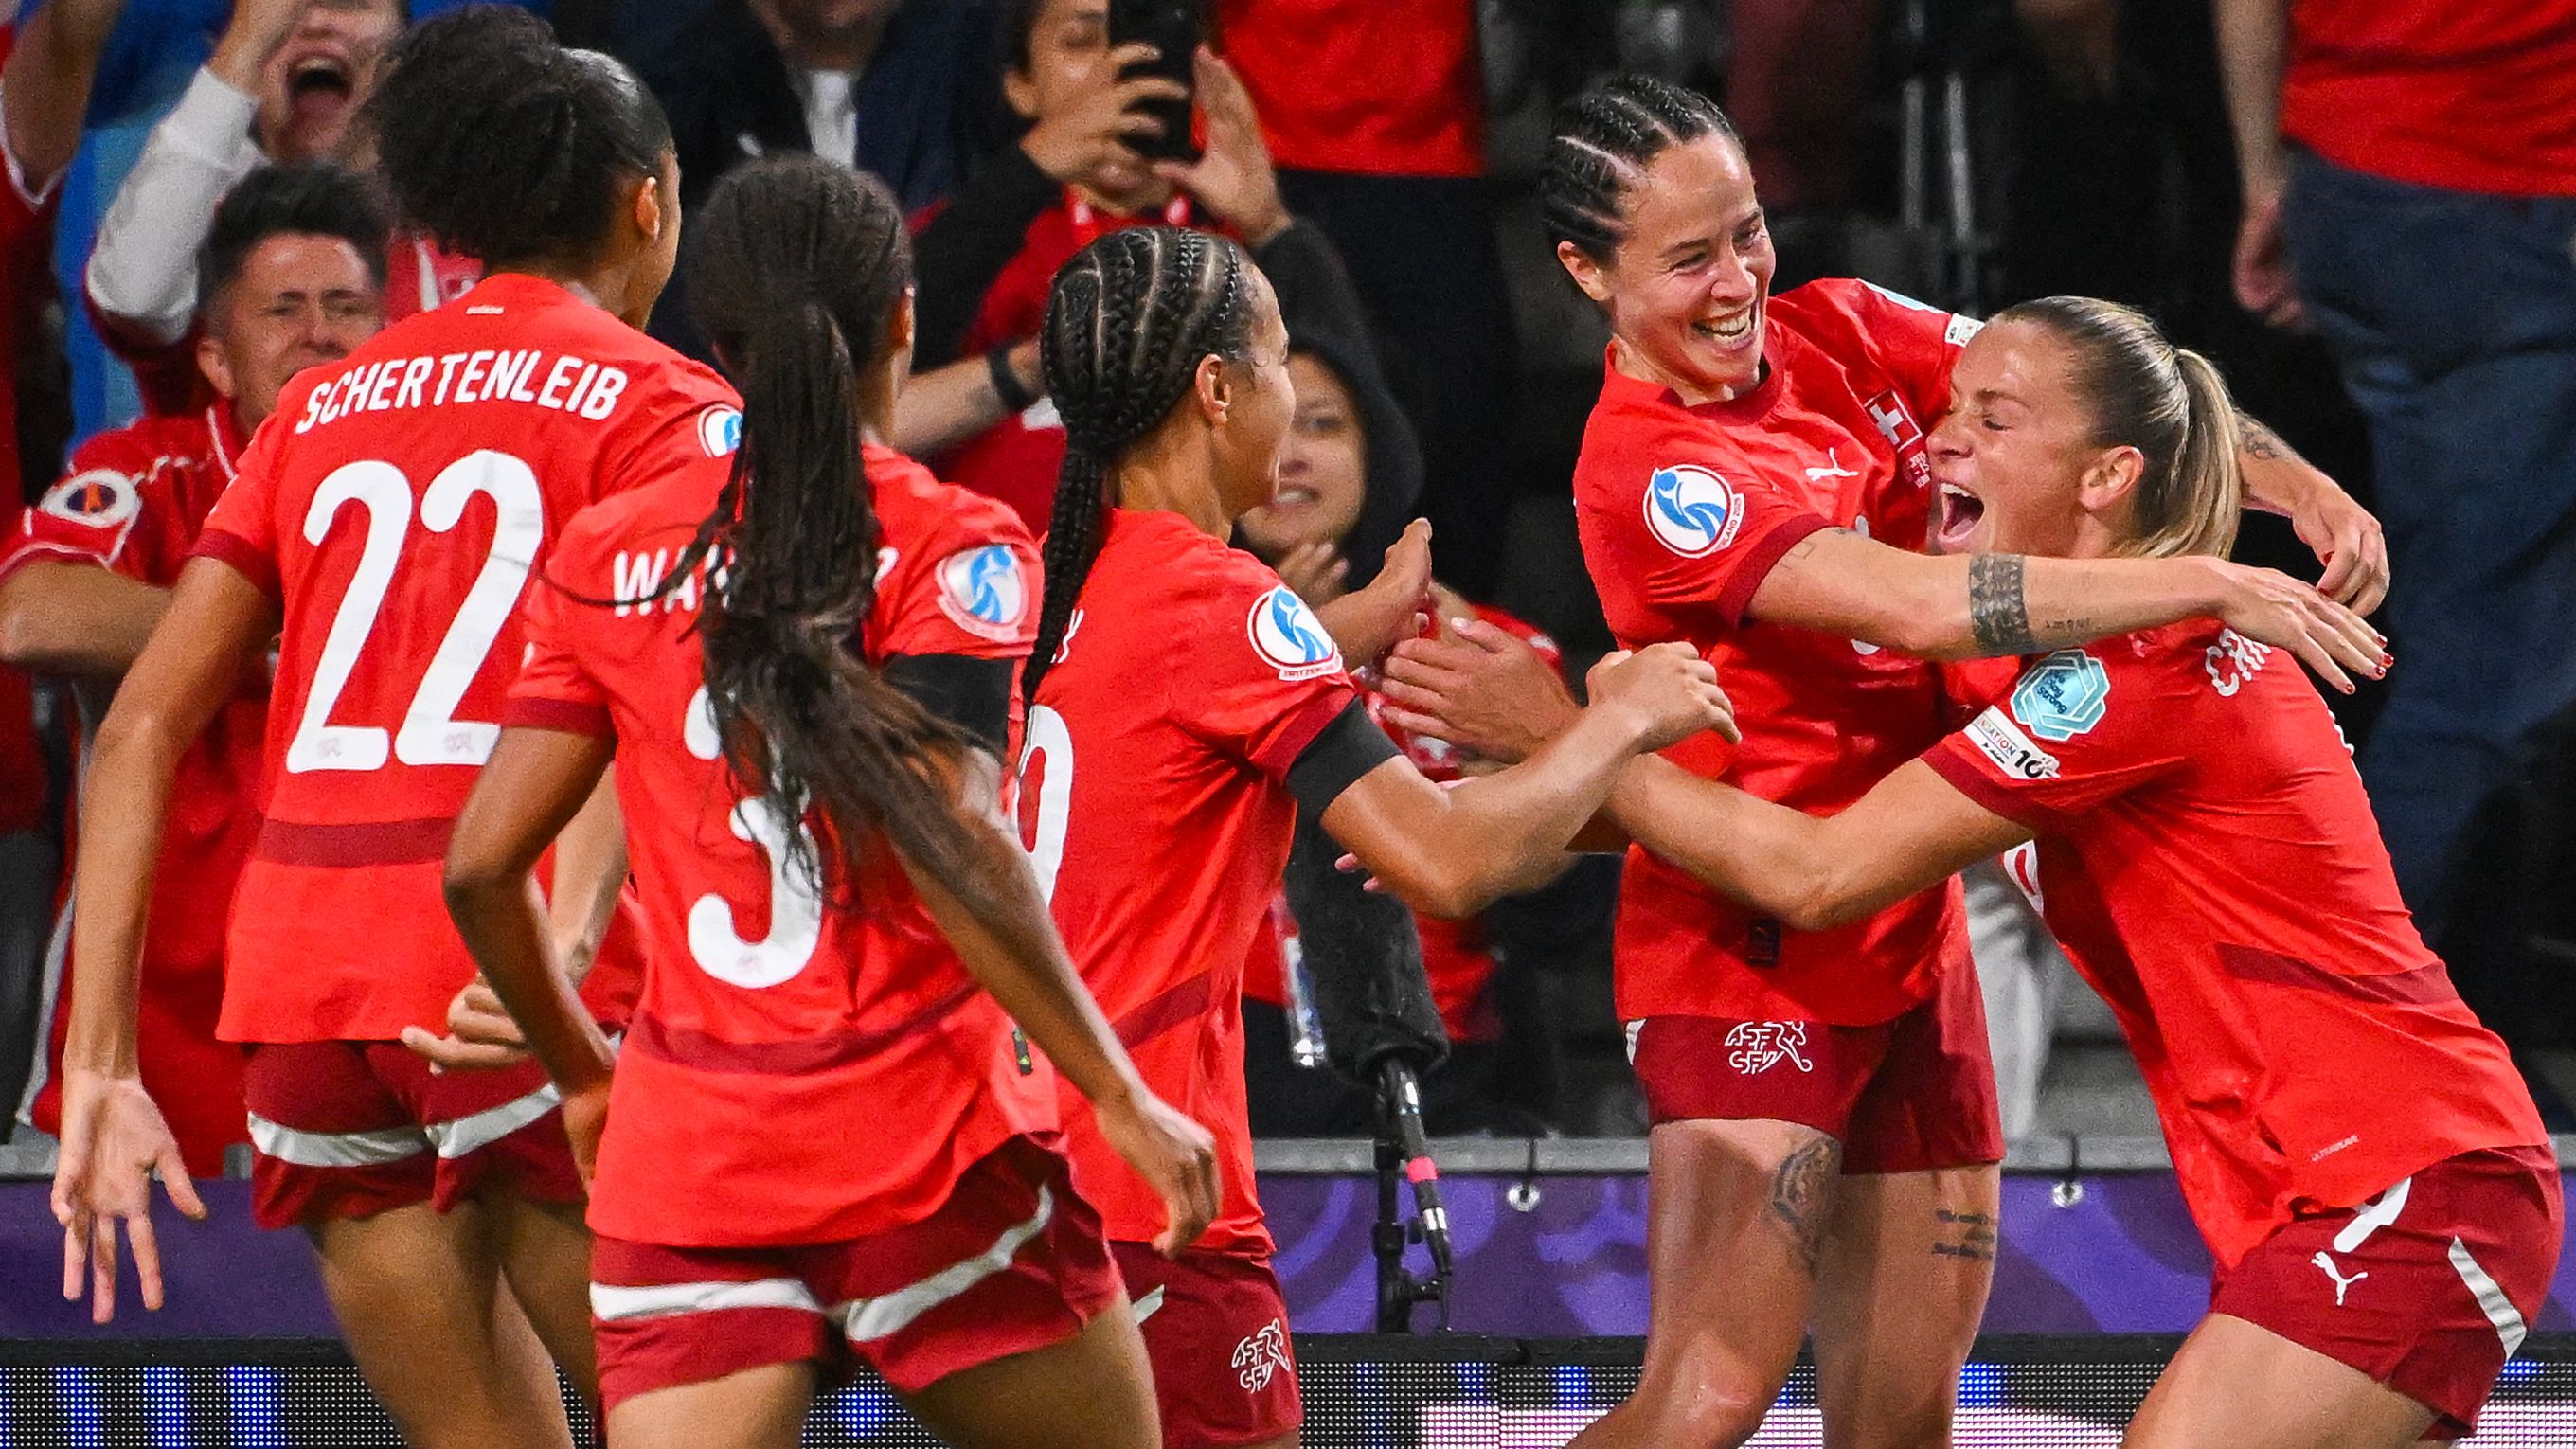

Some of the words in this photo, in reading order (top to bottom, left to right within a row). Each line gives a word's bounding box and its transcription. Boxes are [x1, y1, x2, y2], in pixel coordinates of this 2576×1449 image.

[295, 349, 628, 435] SCHERTENLEIB
[286, 448, 544, 774] 22
[2036, 686, 2068, 715] Strong
[683, 684, 823, 988] 3
